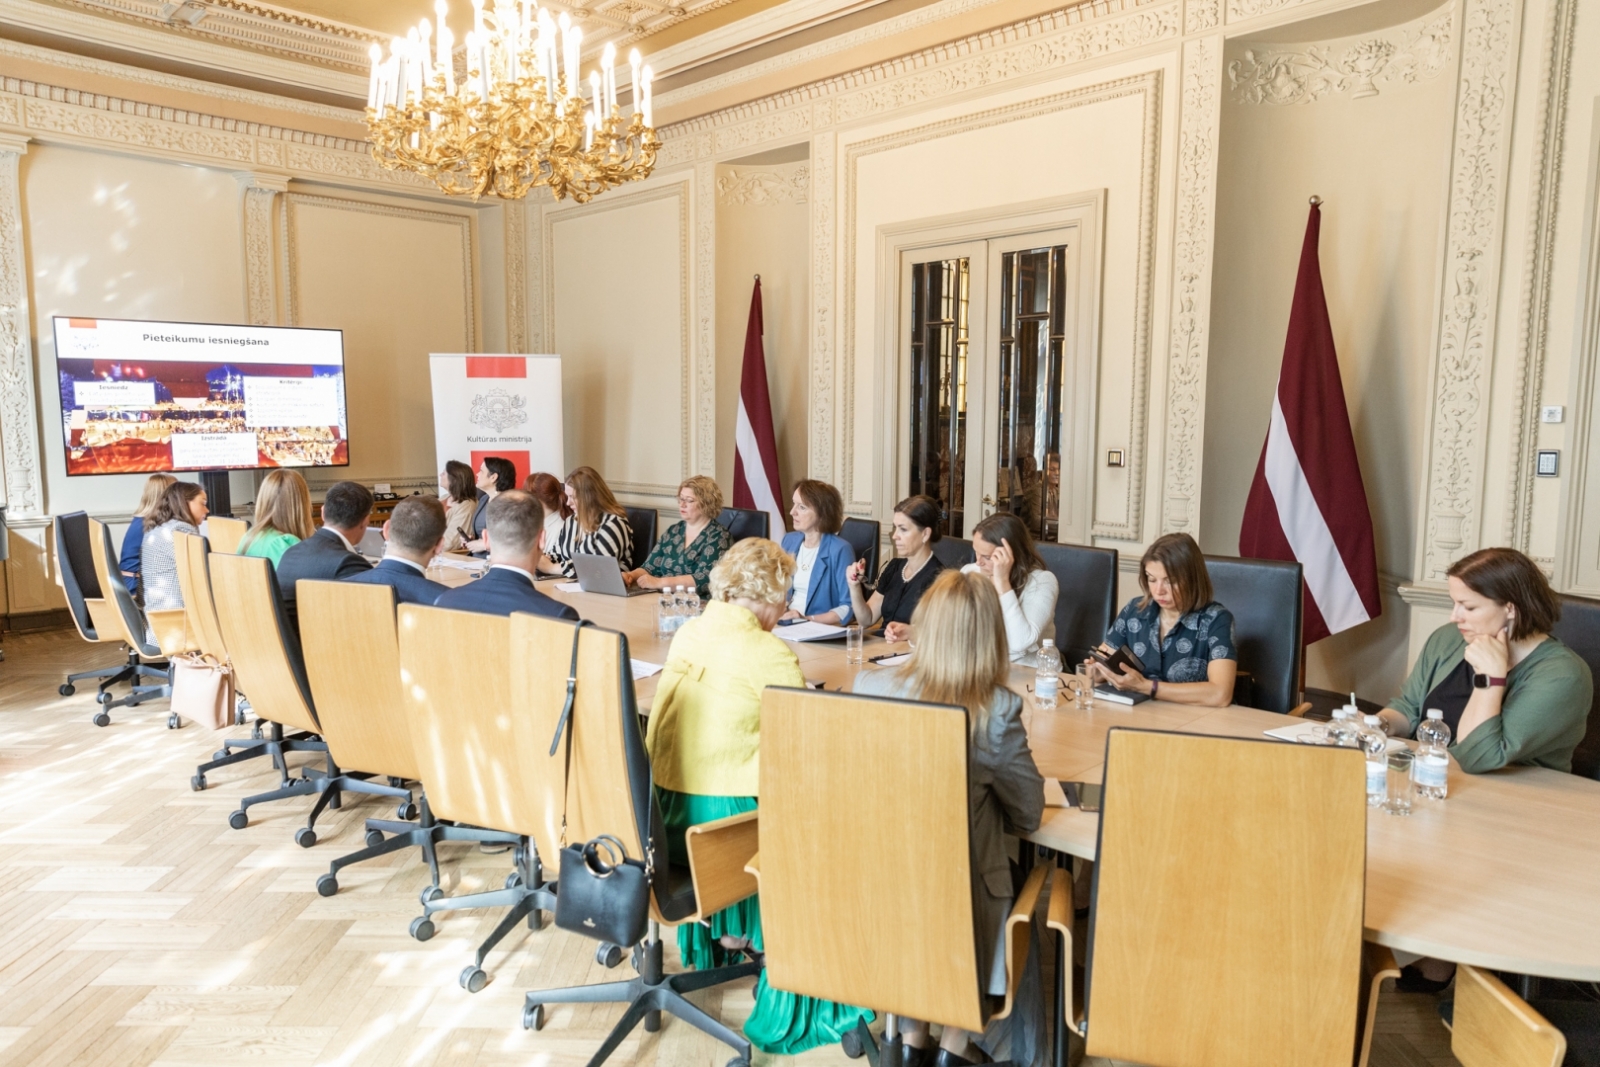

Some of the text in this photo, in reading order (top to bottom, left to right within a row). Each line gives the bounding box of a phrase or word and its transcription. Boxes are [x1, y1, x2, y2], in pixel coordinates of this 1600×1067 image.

[142, 333, 270, 347] Pieteikumu iesniegšana
[466, 435, 532, 444] Kultūras ministrija
